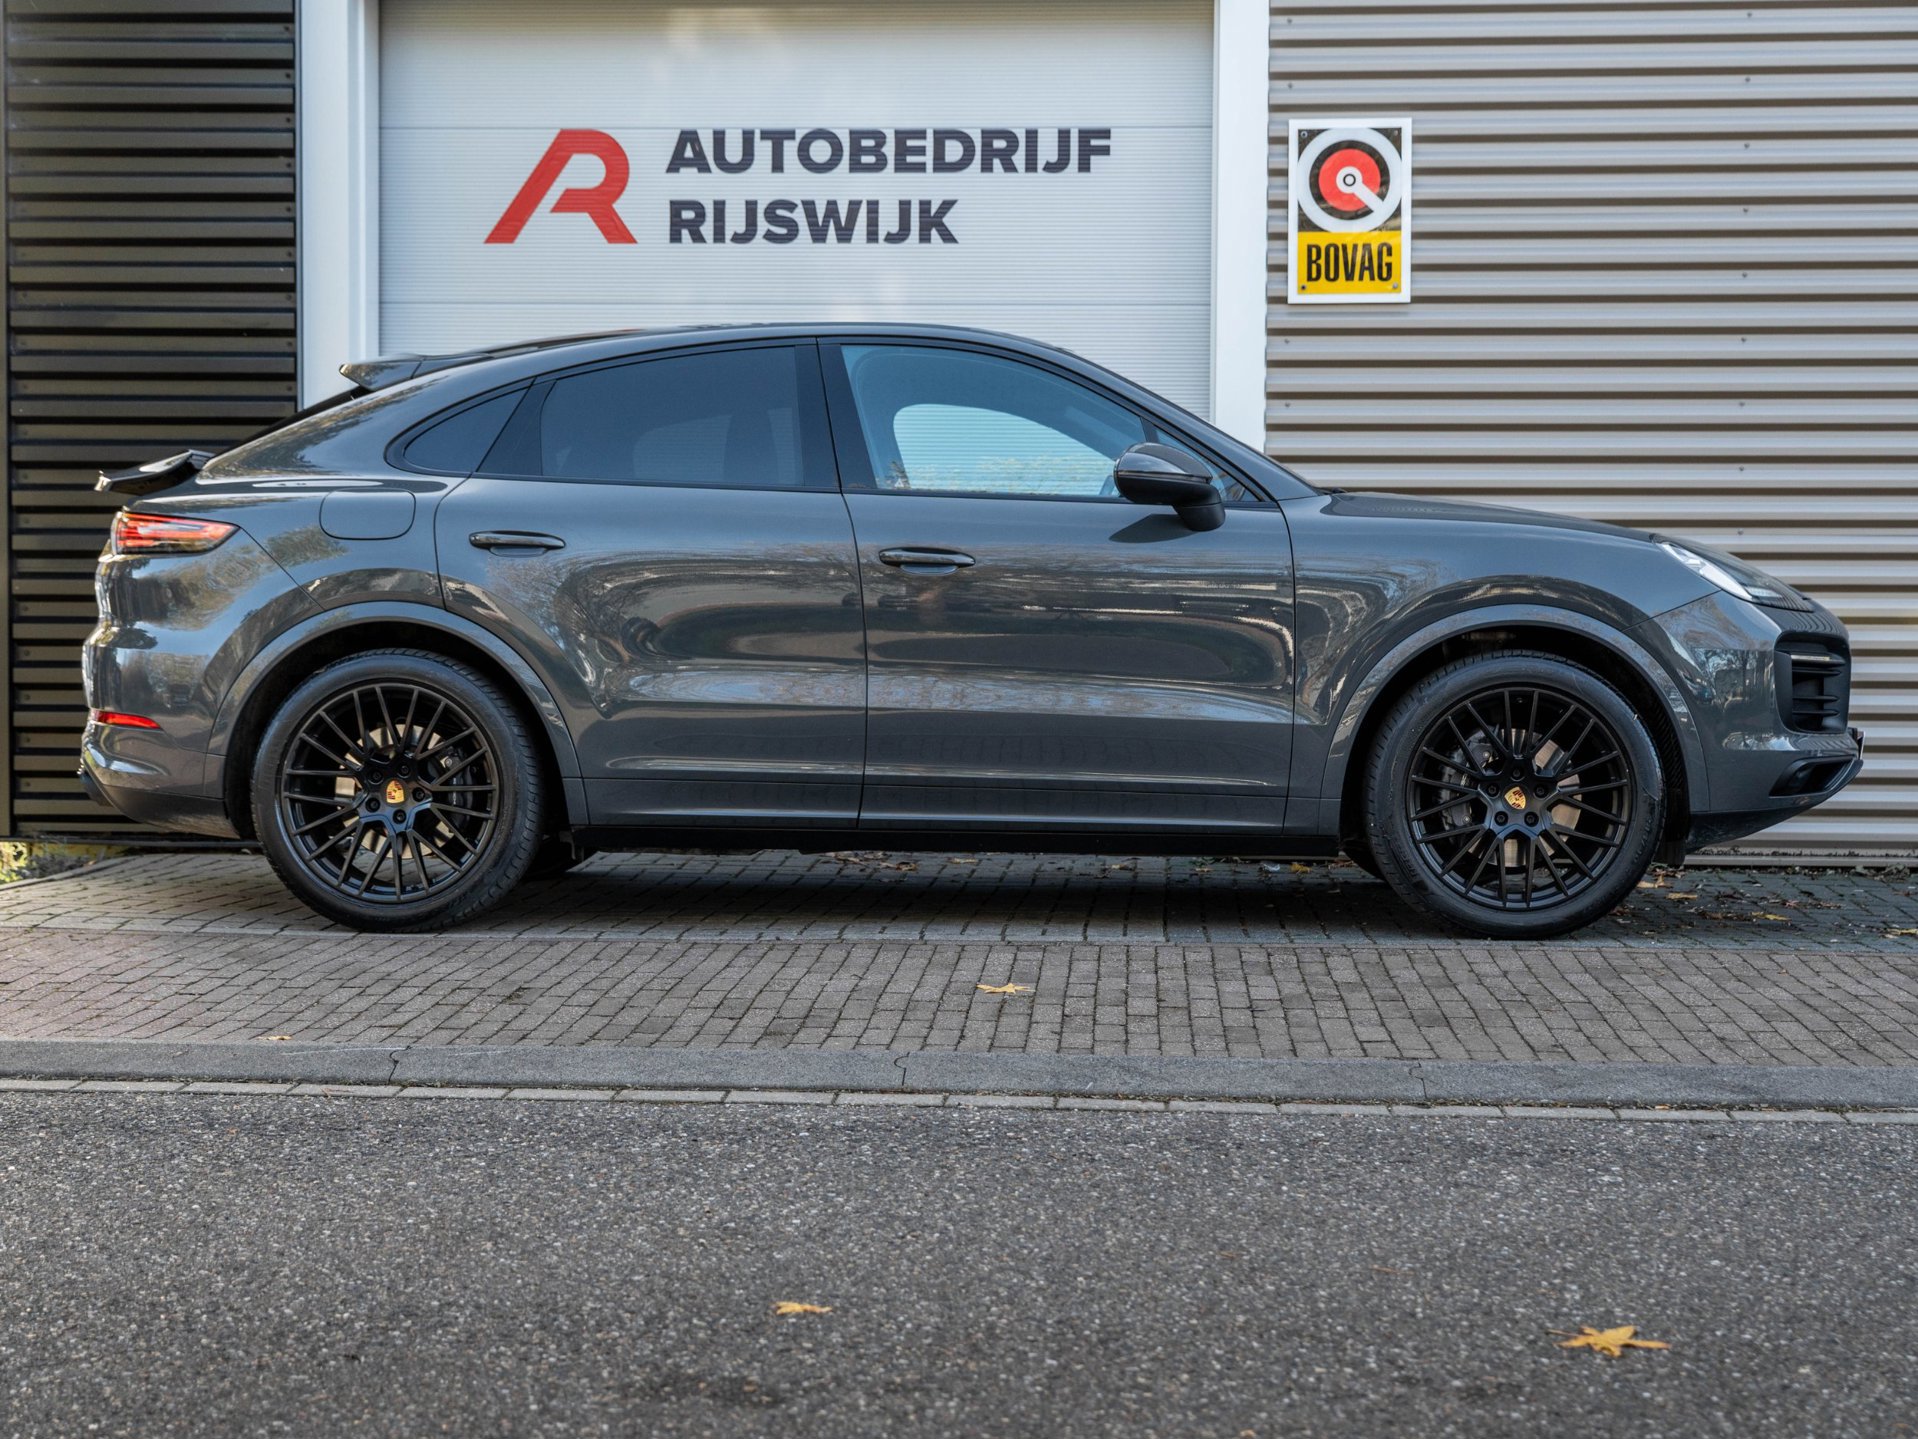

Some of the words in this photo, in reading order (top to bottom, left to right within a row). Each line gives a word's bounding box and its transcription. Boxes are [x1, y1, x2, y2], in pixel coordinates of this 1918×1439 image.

[665, 128, 1112, 174] AUTOBEDRIJF
[668, 199, 959, 245] RIJSWIJK
[1306, 242, 1393, 283] BOVAG
